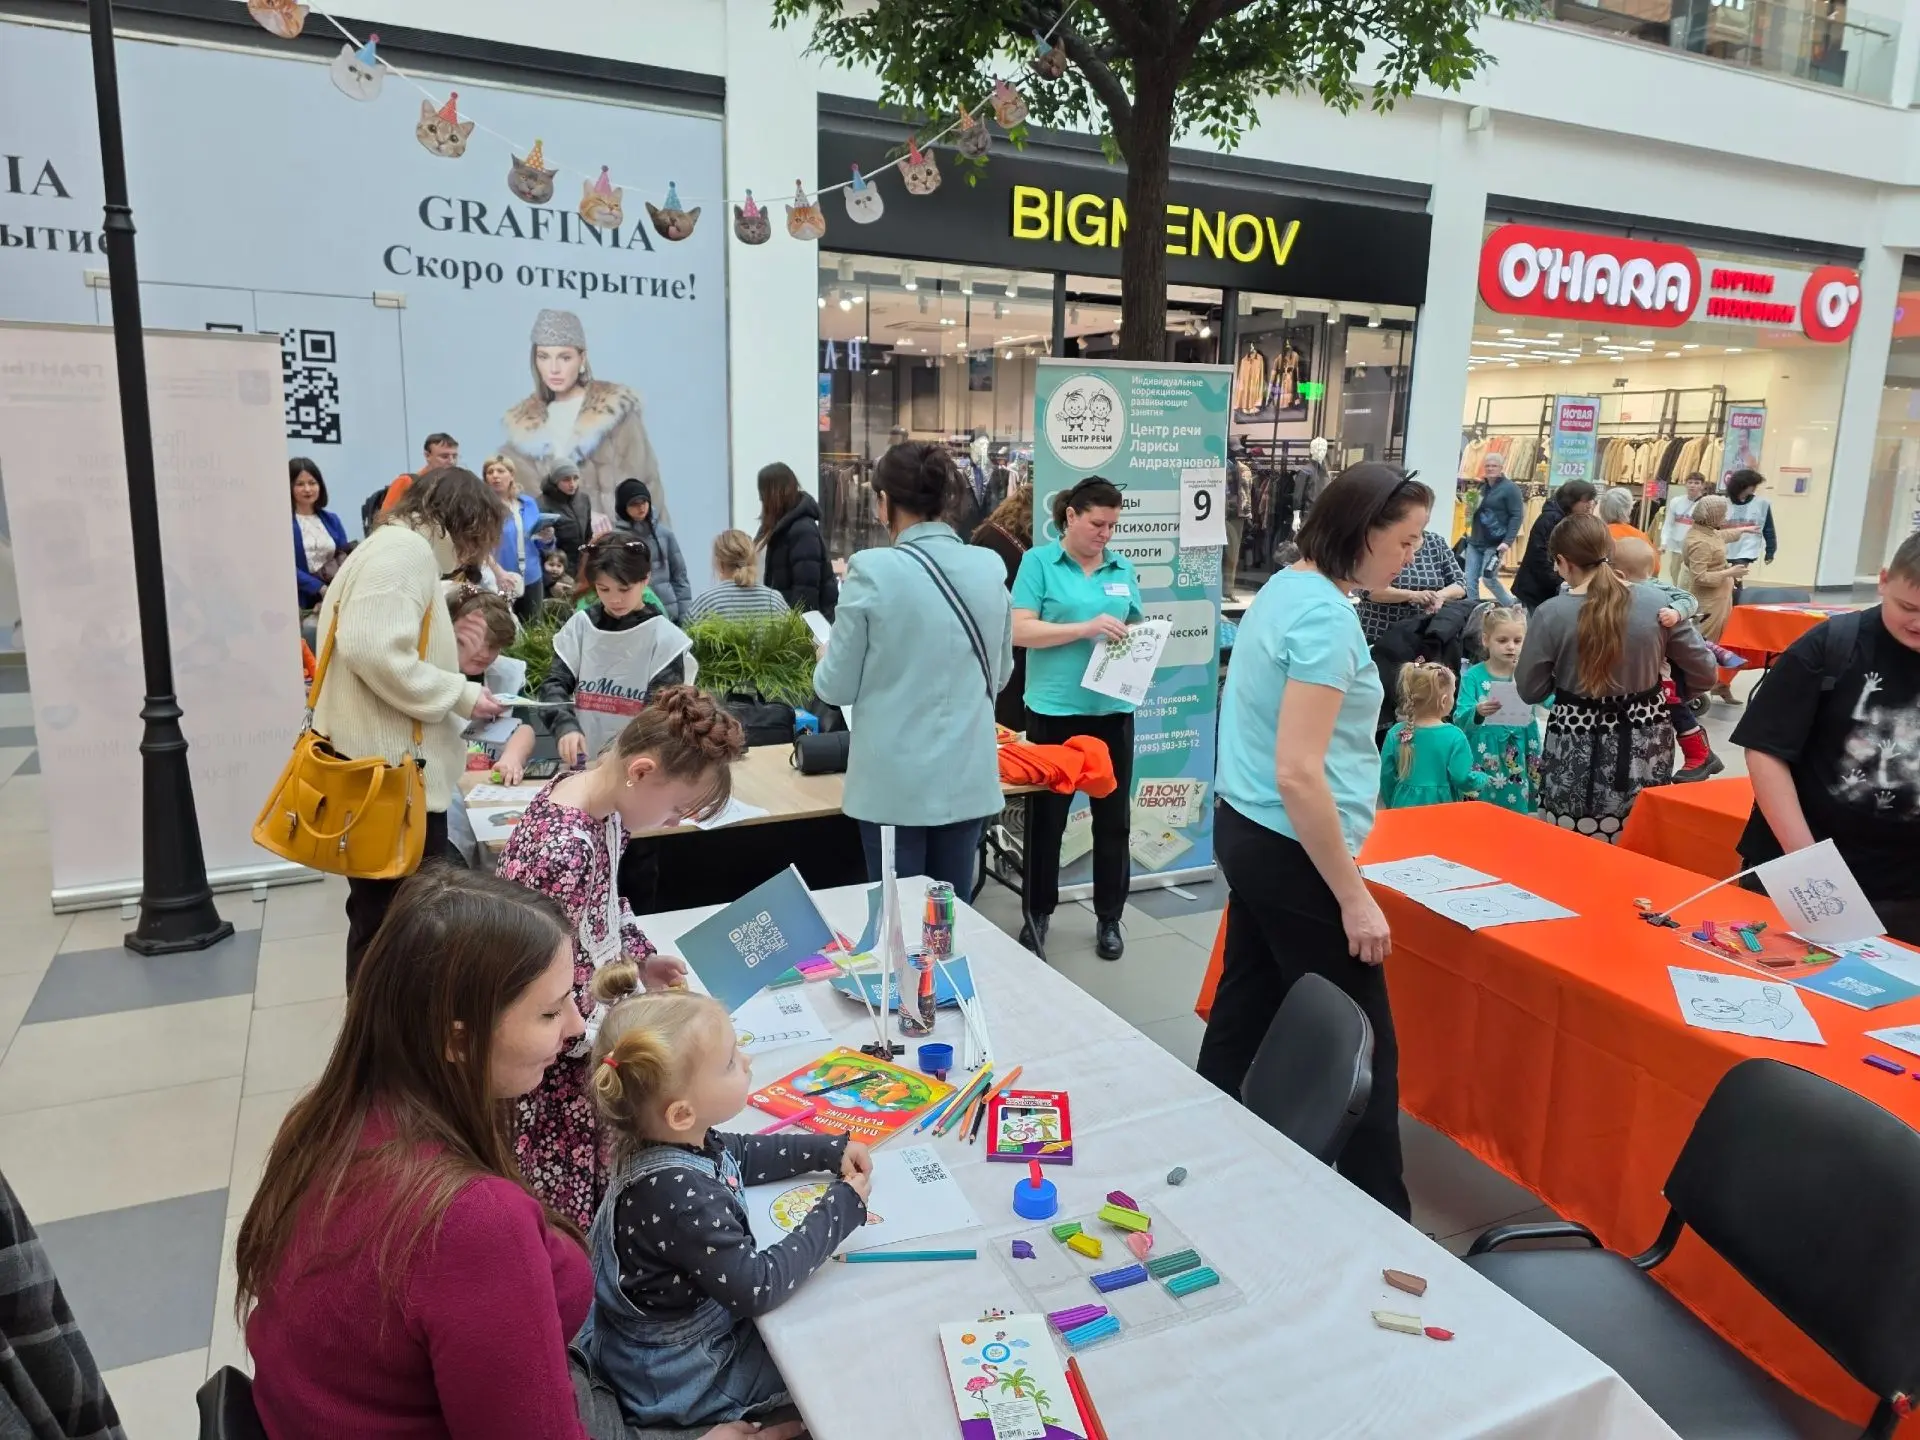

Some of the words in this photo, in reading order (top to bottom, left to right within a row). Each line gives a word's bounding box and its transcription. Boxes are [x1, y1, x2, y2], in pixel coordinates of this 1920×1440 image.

[383, 244, 504, 289] Скоро
[516, 264, 697, 300] открытие!
[1500, 243, 1691, 312] O'HARA
[1131, 375, 1204, 387] Индивидуальные
[1131, 388, 1193, 398] коррекционно-
[1130, 398, 1188, 408] развивающие
[1130, 409, 1164, 417] занятия
[1130, 422, 1169, 438] Центр
[1172, 426, 1202, 438] речи
[1061, 434, 1090, 443] ЦЕНТР
[1091, 434, 1112, 443] РЕЧИ
[1129, 440, 1179, 454] Ларисы
[1129, 456, 1220, 471] Андрахановой
[1557, 462, 1585, 475] 2025
[1193, 489, 1212, 521] 9
[1155, 784, 1190, 797] ХОЧУ
[1137, 796, 1187, 808] ГОВОРИТЬ
[825, 1108, 885, 1126] PLASTICINE
[813, 1115, 880, 1136] ПЛАСТИЛИН
